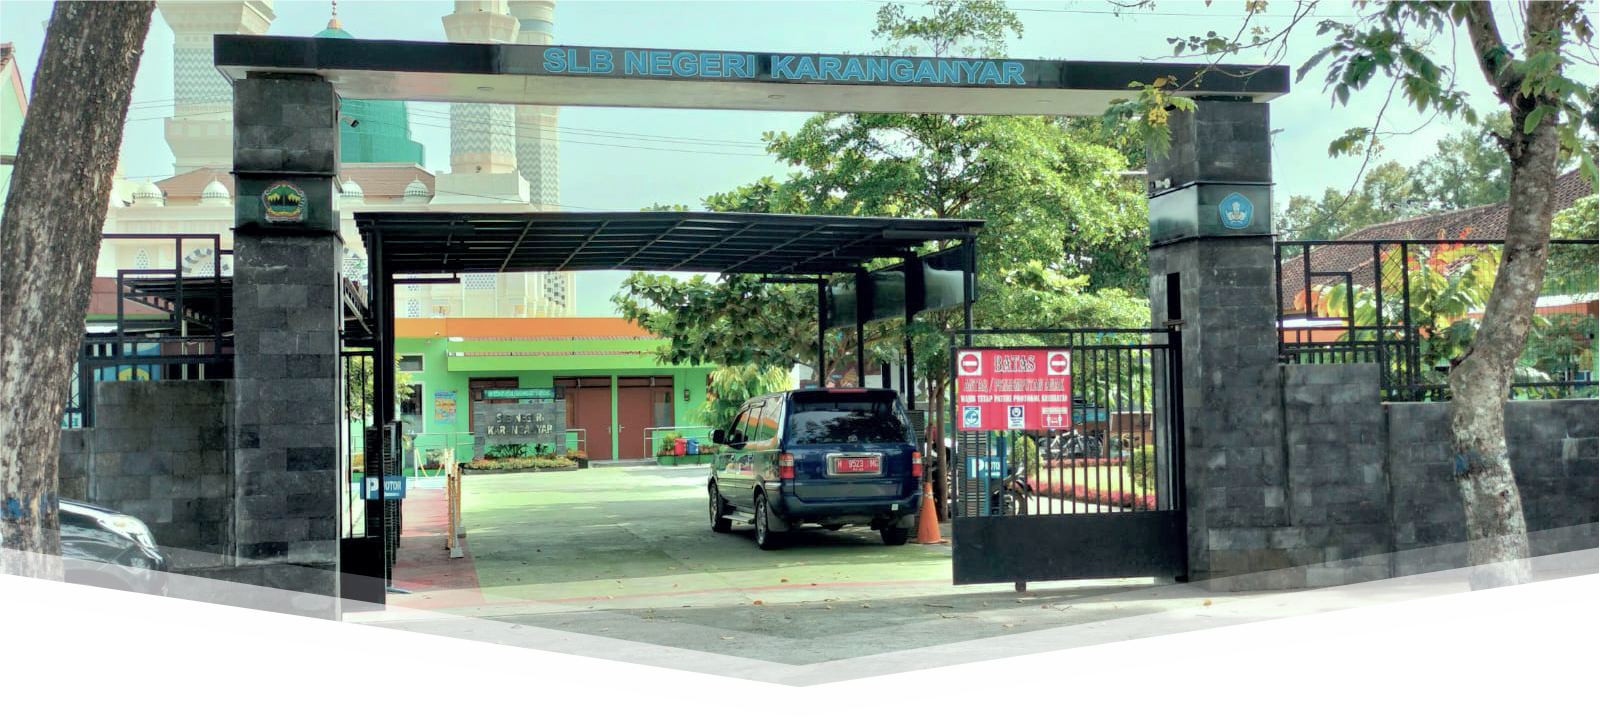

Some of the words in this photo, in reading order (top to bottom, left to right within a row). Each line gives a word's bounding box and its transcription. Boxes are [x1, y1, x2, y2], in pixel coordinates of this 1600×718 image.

[543, 47, 614, 74] SLB
[624, 50, 755, 78] NEGERI
[771, 55, 1026, 85] KARANGANYAR
[994, 355, 1036, 373] BATAS
[496, 413, 514, 423] SB
[515, 413, 545, 423] NEGRI
[487, 425, 553, 435] KARNAYAR
[837, 460, 843, 469] H
[971, 458, 985, 478] P
[985, 461, 1002, 471] MTO
[366, 477, 379, 499] P
[384, 480, 402, 491] OTOR
